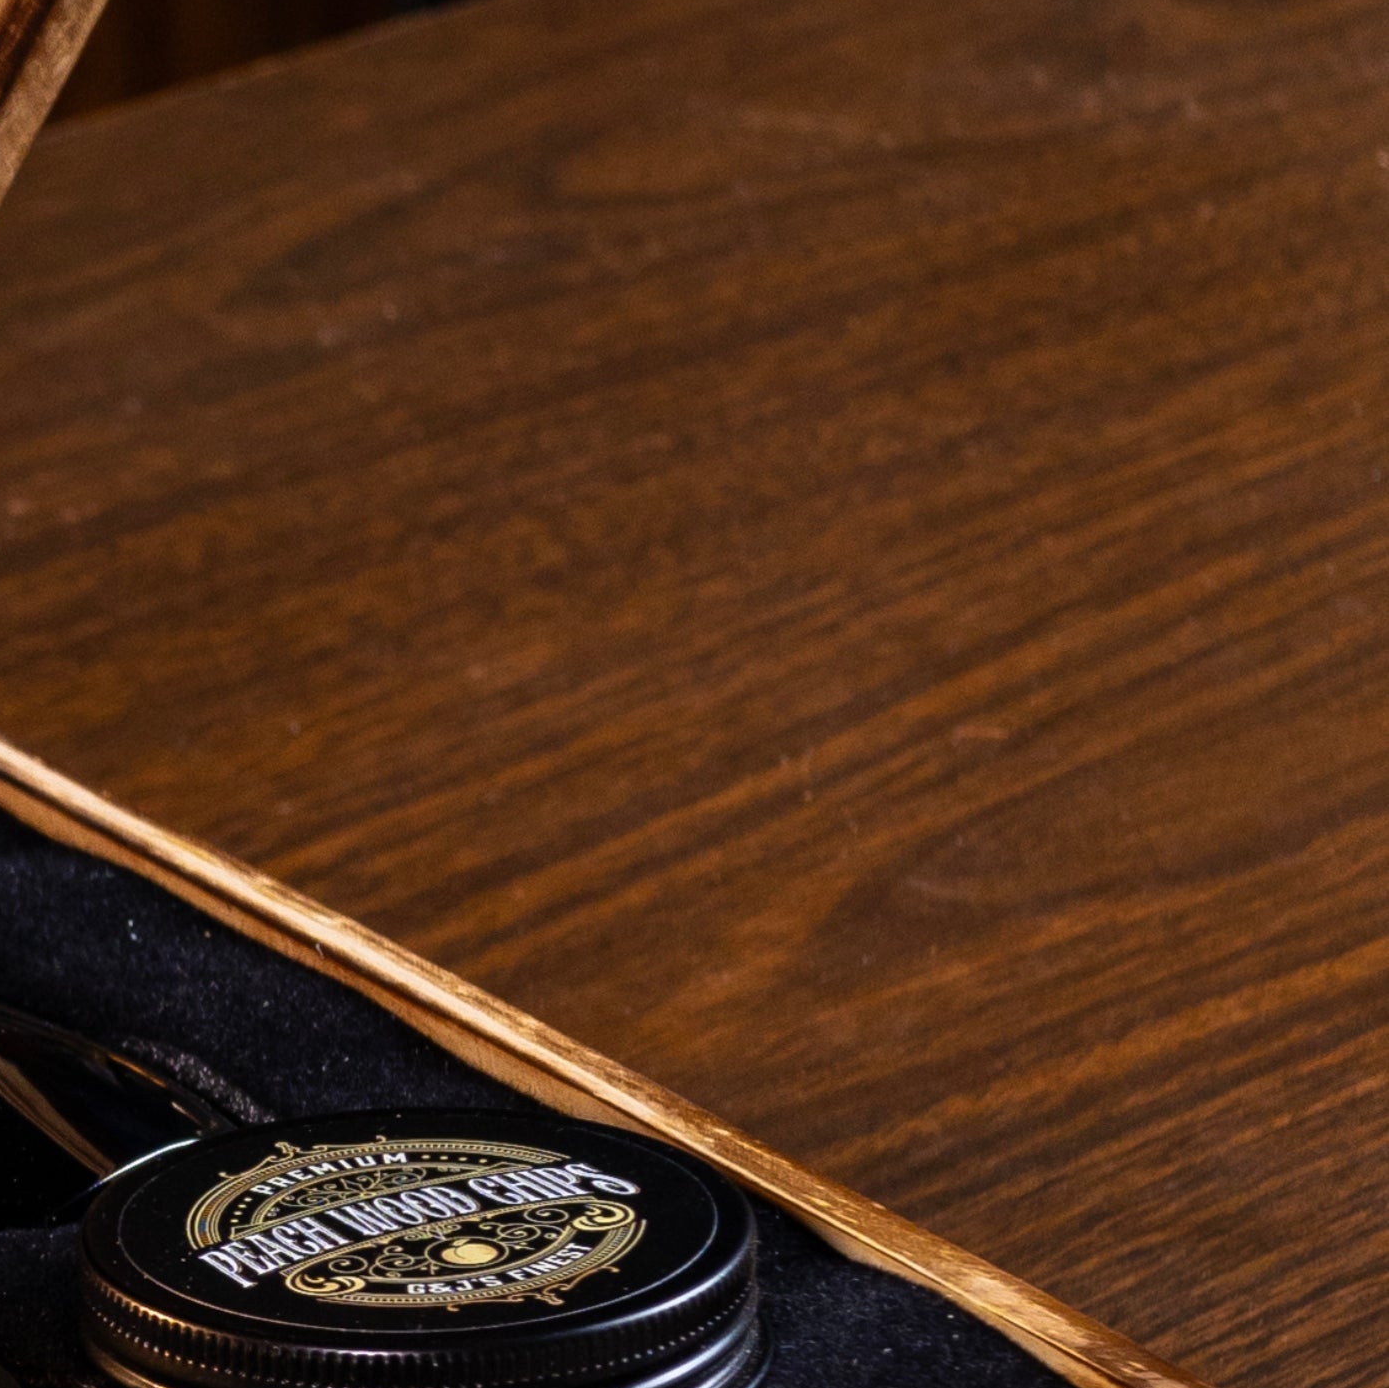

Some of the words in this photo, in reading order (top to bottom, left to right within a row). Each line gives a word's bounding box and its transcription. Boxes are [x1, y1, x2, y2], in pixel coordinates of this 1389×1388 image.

[252, 1152, 408, 1195] PREMIUM
[198, 1216, 349, 1288] PEACH
[326, 1184, 480, 1236] WOOD
[469, 1162, 640, 1205] CHIPS
[406, 1275, 504, 1295] G&J'S
[513, 1242, 593, 1281] FINEST
